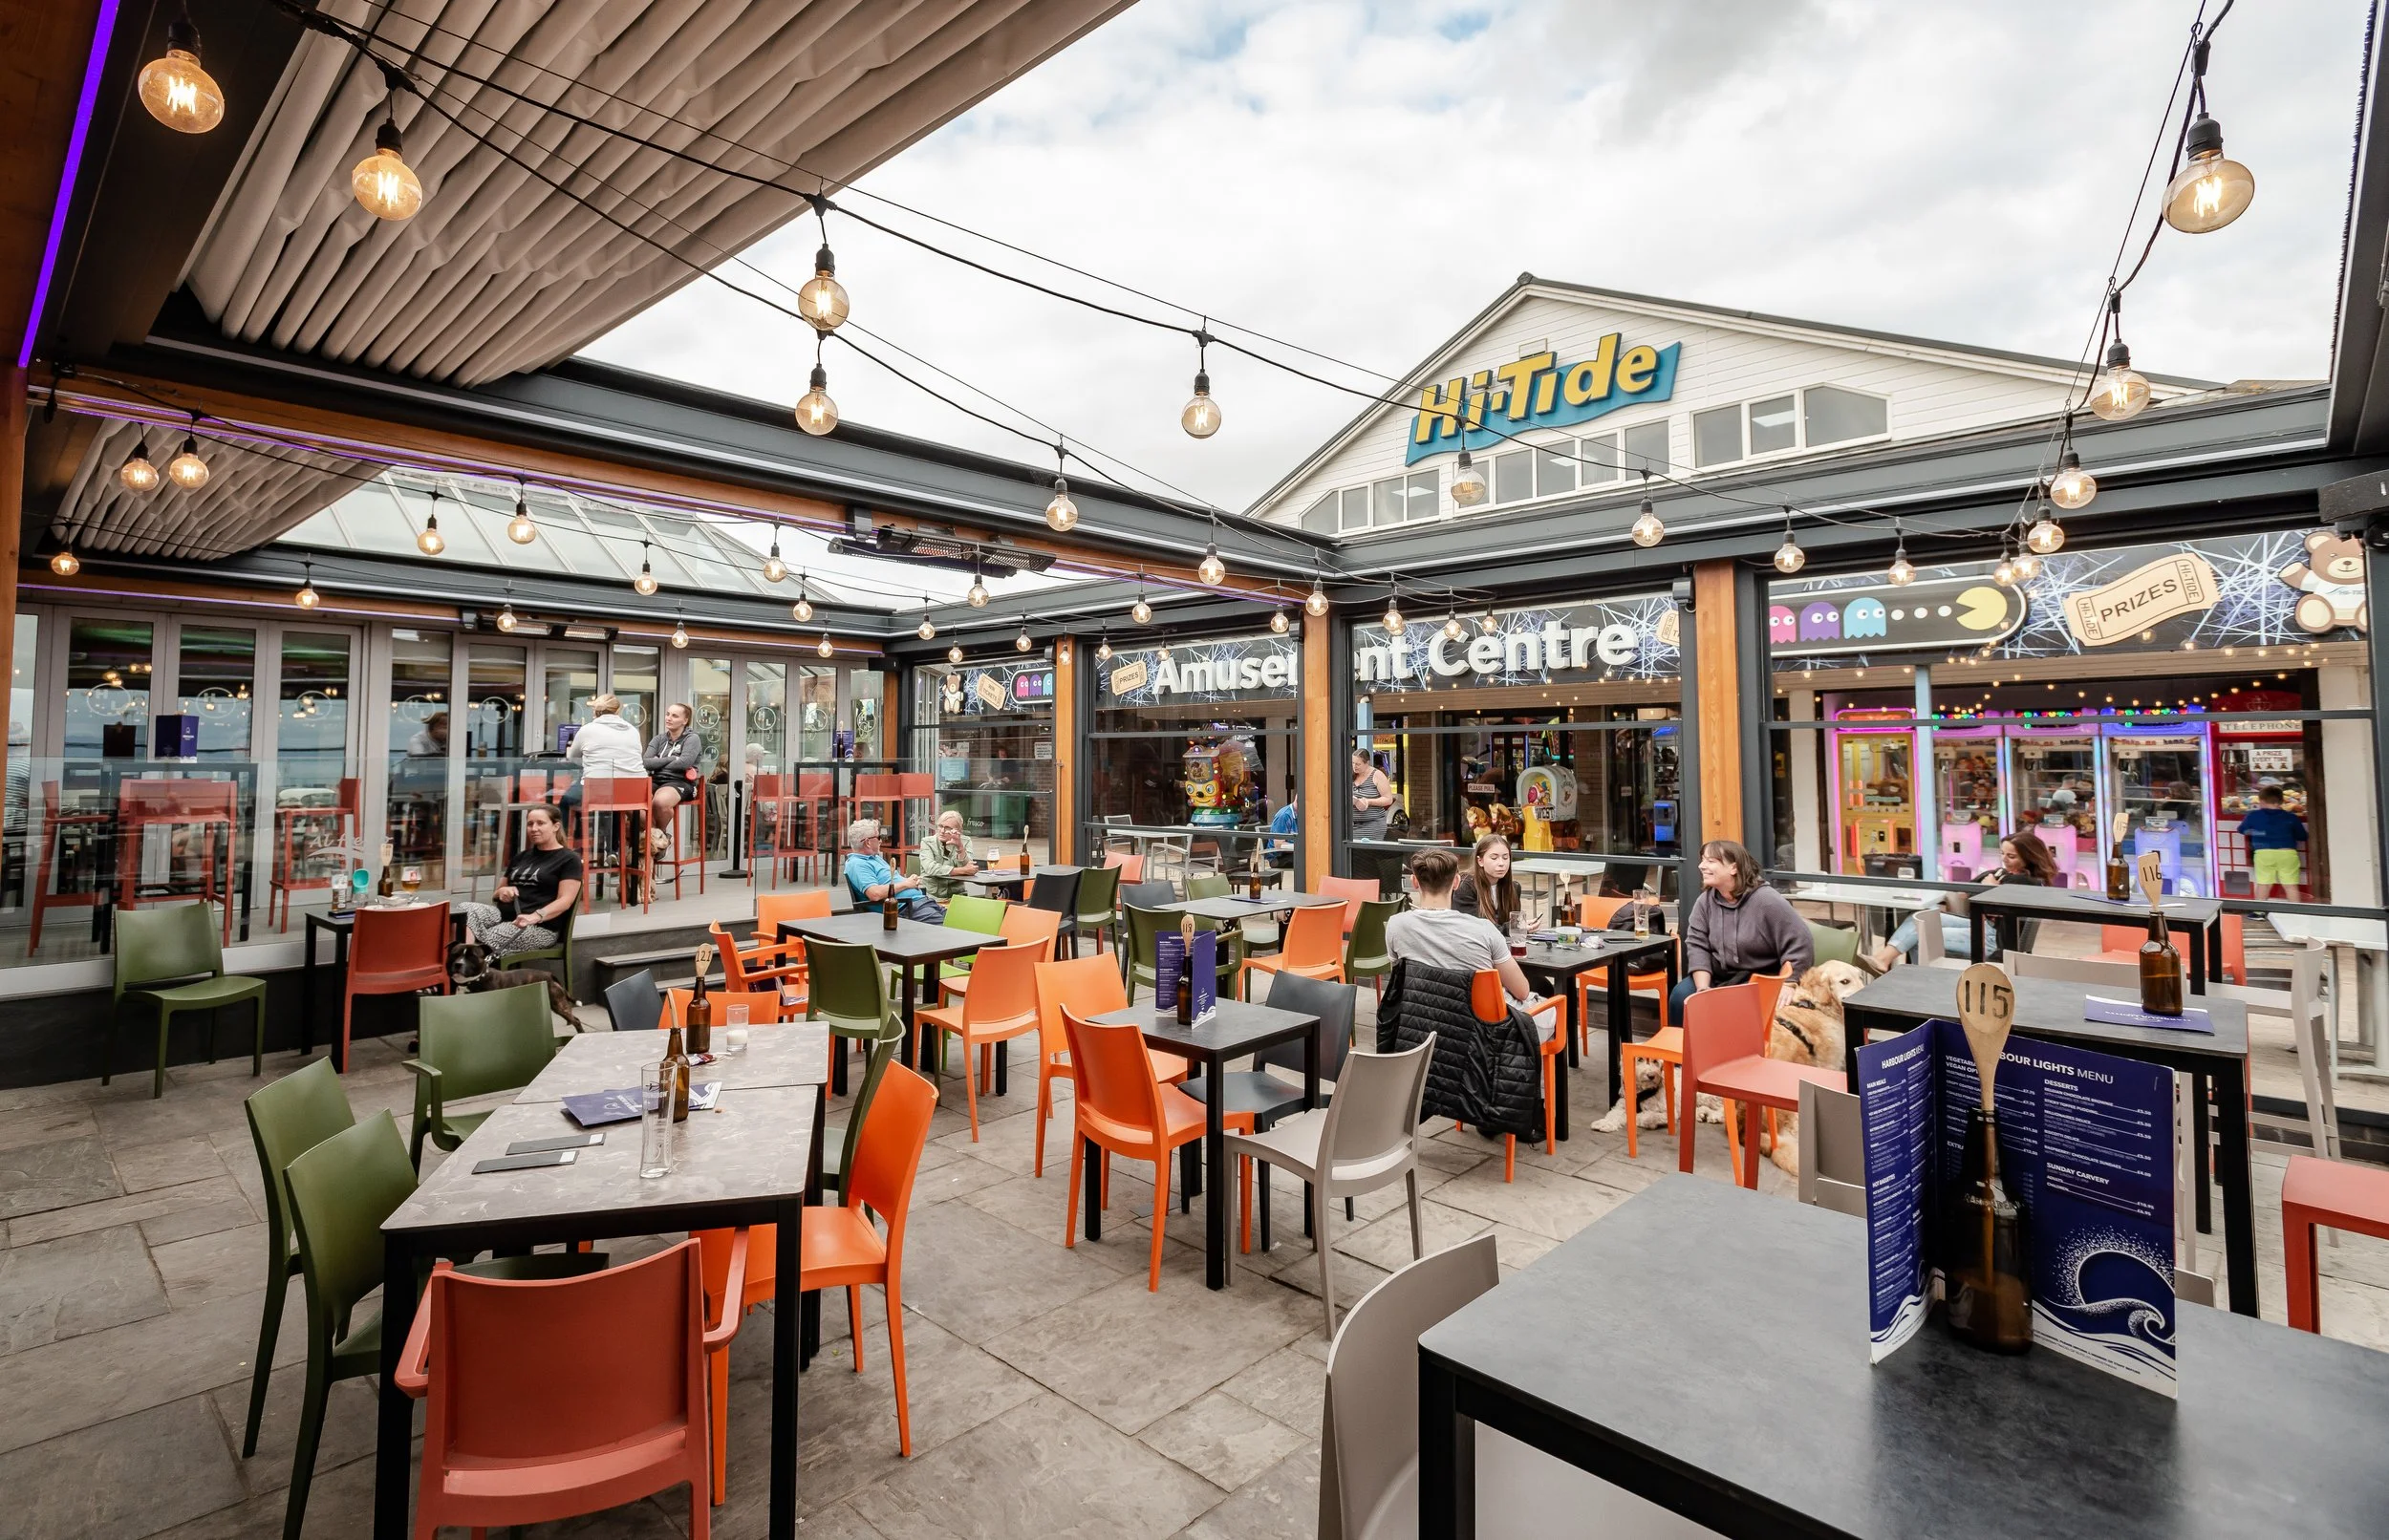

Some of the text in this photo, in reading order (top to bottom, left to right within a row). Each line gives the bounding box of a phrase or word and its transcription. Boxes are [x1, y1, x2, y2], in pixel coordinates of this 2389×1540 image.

[2180, 564, 2200, 600] HI-TIDE
[2100, 579, 2178, 622] PRIZES
[1428, 621, 1640, 677] Centre
[1119, 672, 1139, 684] PRIZES
[2225, 721, 2301, 731] TELEPHONE
[1468, 783, 1483, 792] PLEASE
[2142, 864, 2163, 882] 116
[696, 950, 712, 963] 121
[1965, 980, 2012, 1019] 115
[1881, 1055, 1905, 1069] HARBOUR
[1946, 1061, 1967, 1071] VEGAN
[2033, 1059, 2075, 1076] LIGHTS
[2077, 1068, 2114, 1084] MENU
[2044, 1079, 2078, 1092] DESSERTS
[2046, 1162, 2110, 1186] SUNDAY CARVERY
